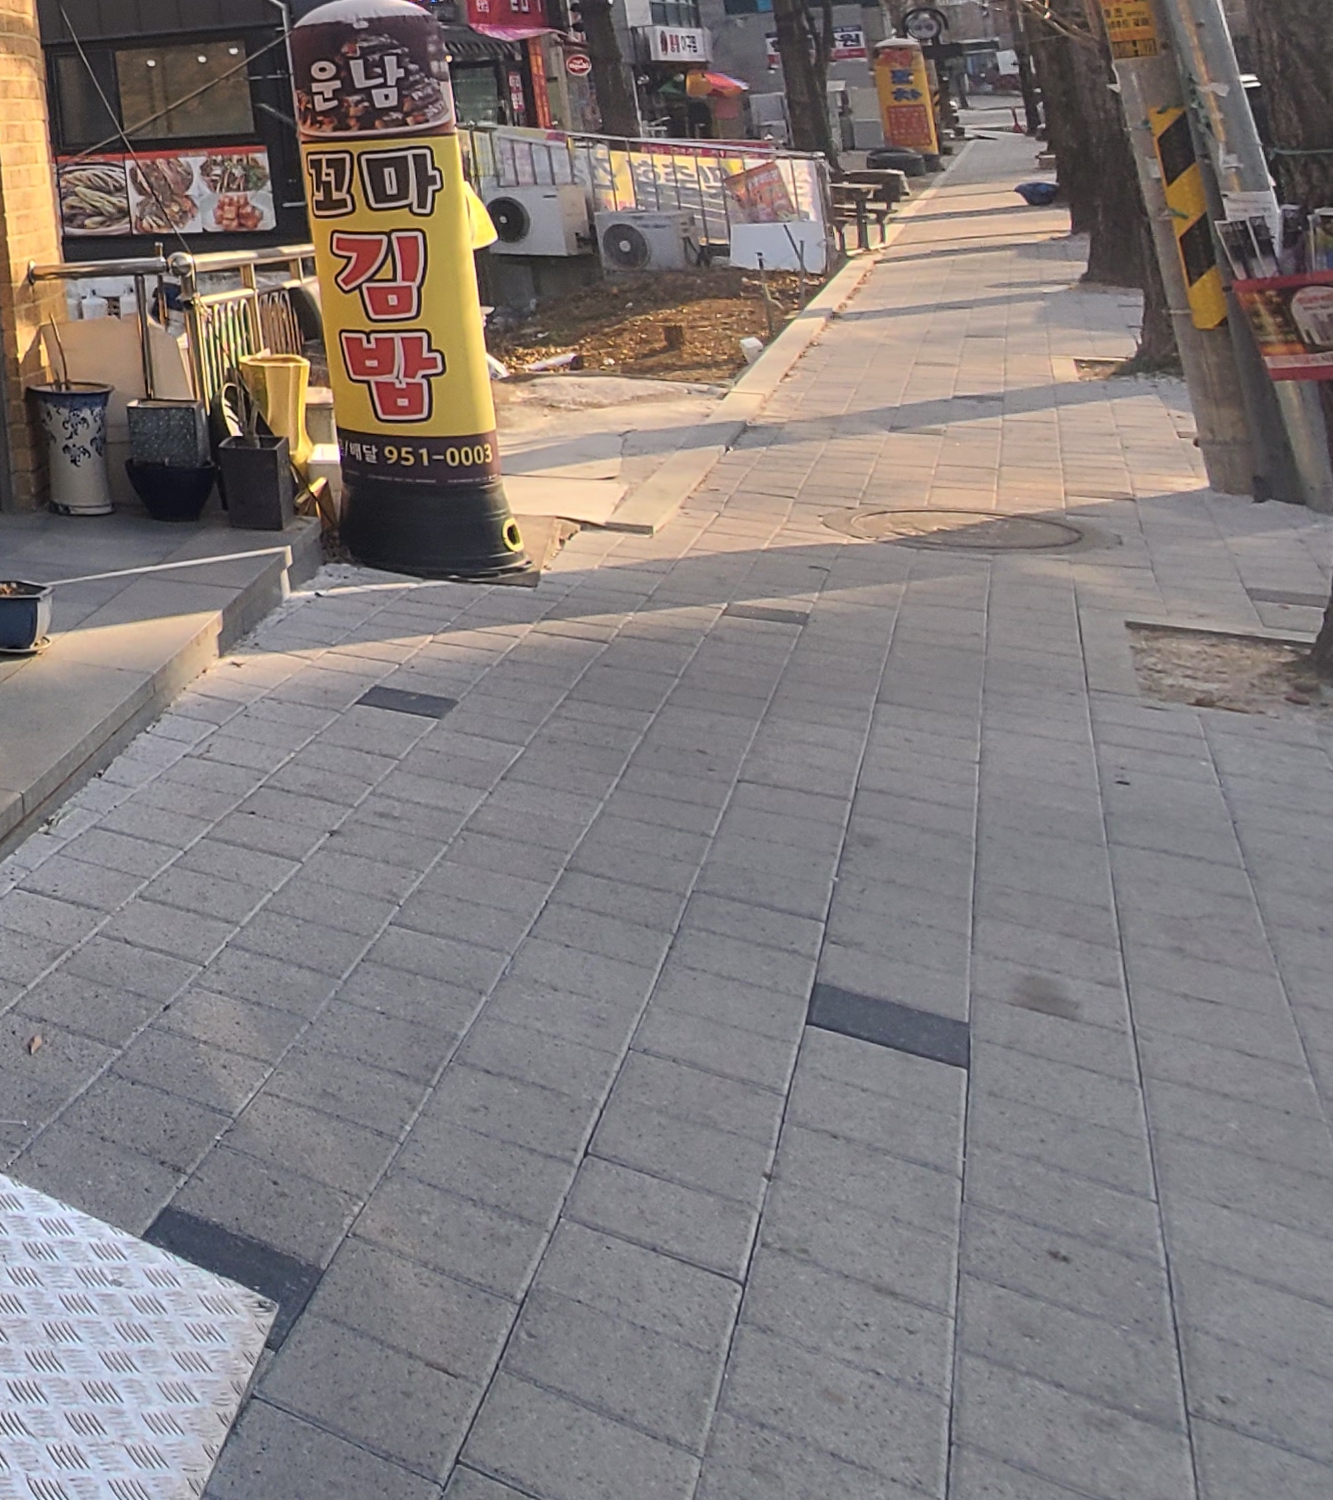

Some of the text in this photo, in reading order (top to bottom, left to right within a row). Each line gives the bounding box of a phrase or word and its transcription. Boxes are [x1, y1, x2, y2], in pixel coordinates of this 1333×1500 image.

[310, 55, 405, 113] 운남
[305, 145, 443, 218] 꼬마
[384, 443, 493, 467] 951-0003
